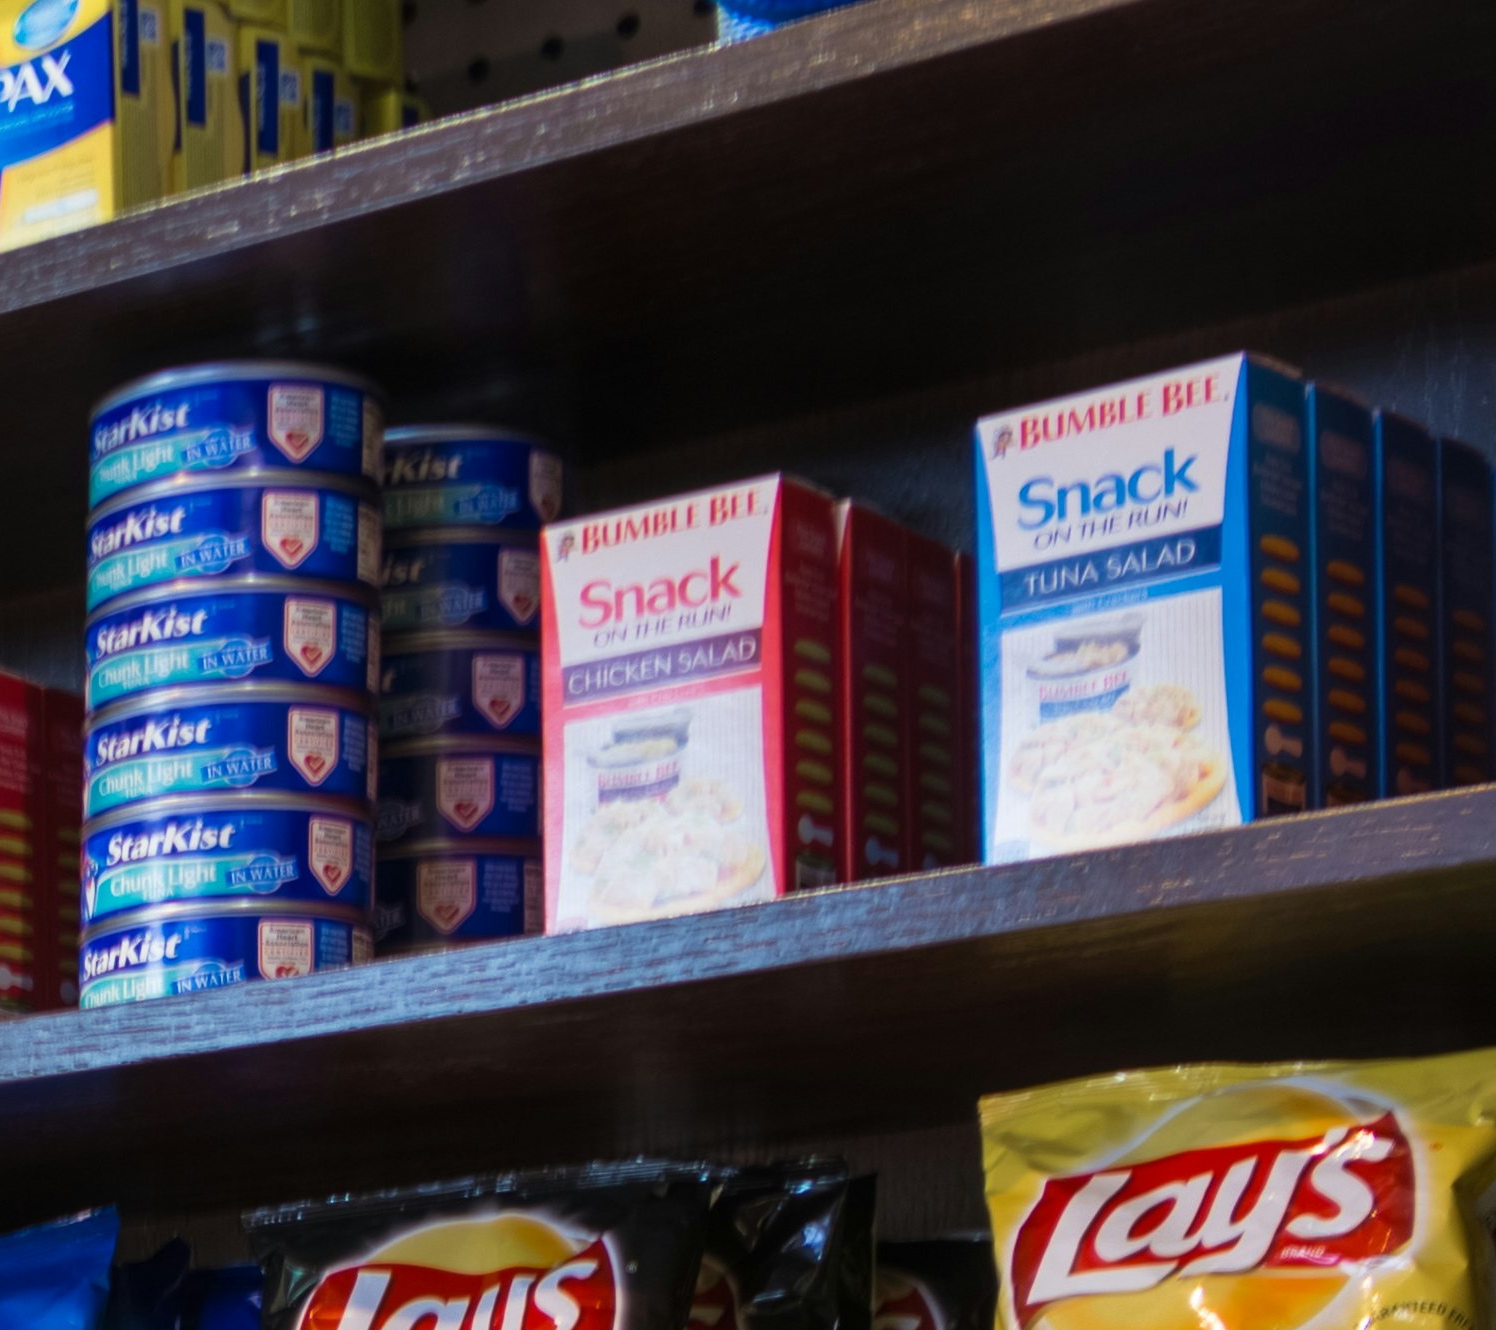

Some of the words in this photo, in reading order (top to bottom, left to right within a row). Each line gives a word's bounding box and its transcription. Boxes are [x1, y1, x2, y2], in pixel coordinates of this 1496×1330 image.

[1020, 394, 1152, 450] BUMBLE
[1162, 376, 1221, 415] BEE
[1018, 447, 1200, 531] Snack
[582, 503, 699, 554] BUMBLE
[711, 488, 761, 524] BEE
[1034, 528, 1071, 549] ON
[1079, 516, 1123, 538] THE
[1127, 500, 1187, 528] RUN!
[579, 555, 741, 629] Snack
[1025, 566, 1098, 596] TUNA
[1107, 541, 1195, 580] SALAD
[96, 609, 207, 657] StarKist
[594, 628, 628, 647] ON
[634, 619, 672, 637] THE
[678, 604, 732, 630] RUN!
[569, 655, 671, 695] CHICKEN
[678, 637, 756, 673] SALAD
[96, 718, 211, 766] StarKist
[107, 824, 236, 865] StarKist
[111, 868, 162, 897] Chunk
[167, 863, 217, 892] Light
[232, 867, 249, 883] IN
[252, 860, 295, 881] WATER
[84, 939, 181, 981] StarKist
